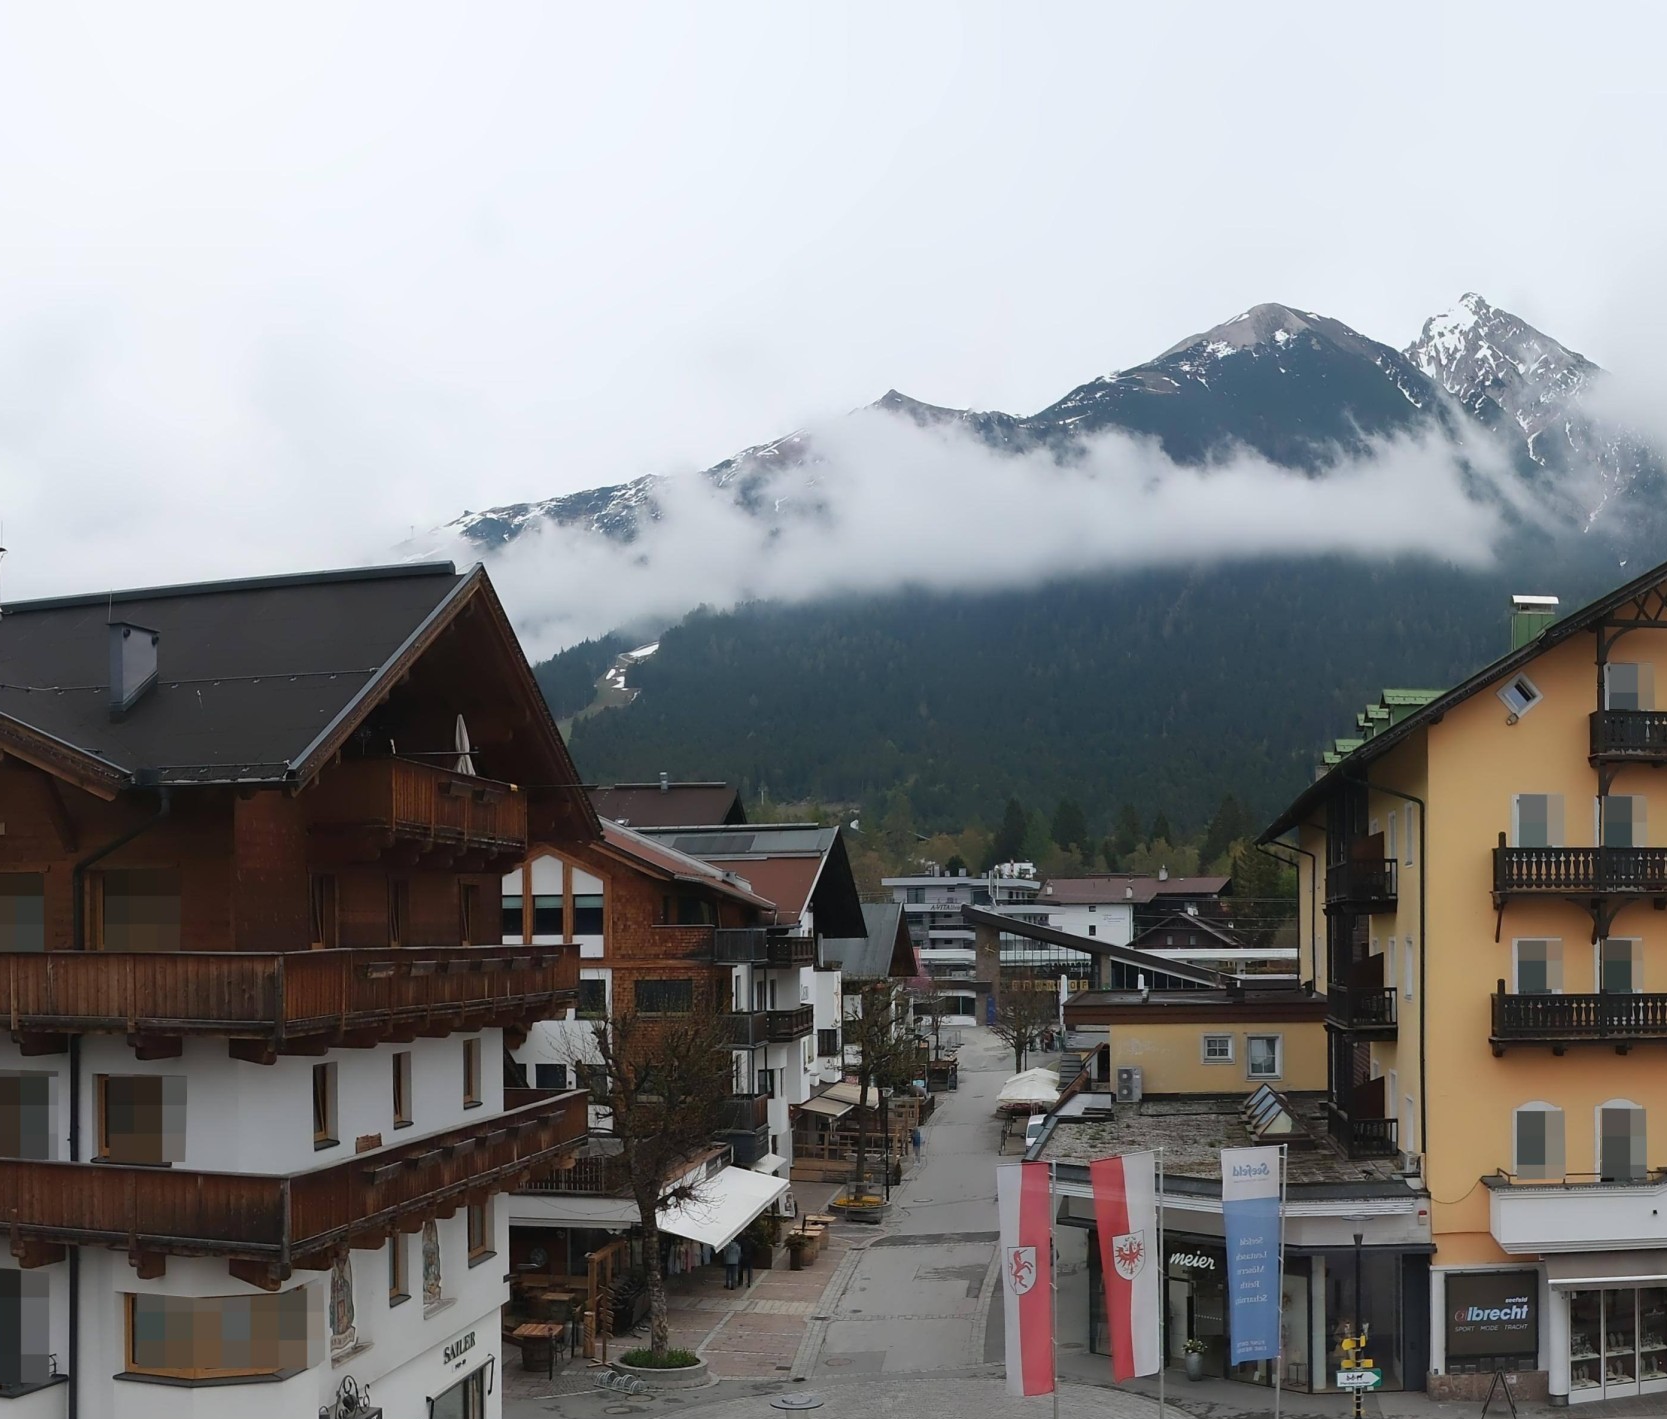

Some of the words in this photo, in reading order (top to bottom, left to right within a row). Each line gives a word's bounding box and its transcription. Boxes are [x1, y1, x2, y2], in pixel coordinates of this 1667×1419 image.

[1169, 1250, 1216, 1270] meier
[1455, 1325, 1476, 1333] SPORT
[443, 1331, 476, 1365] SAILER
